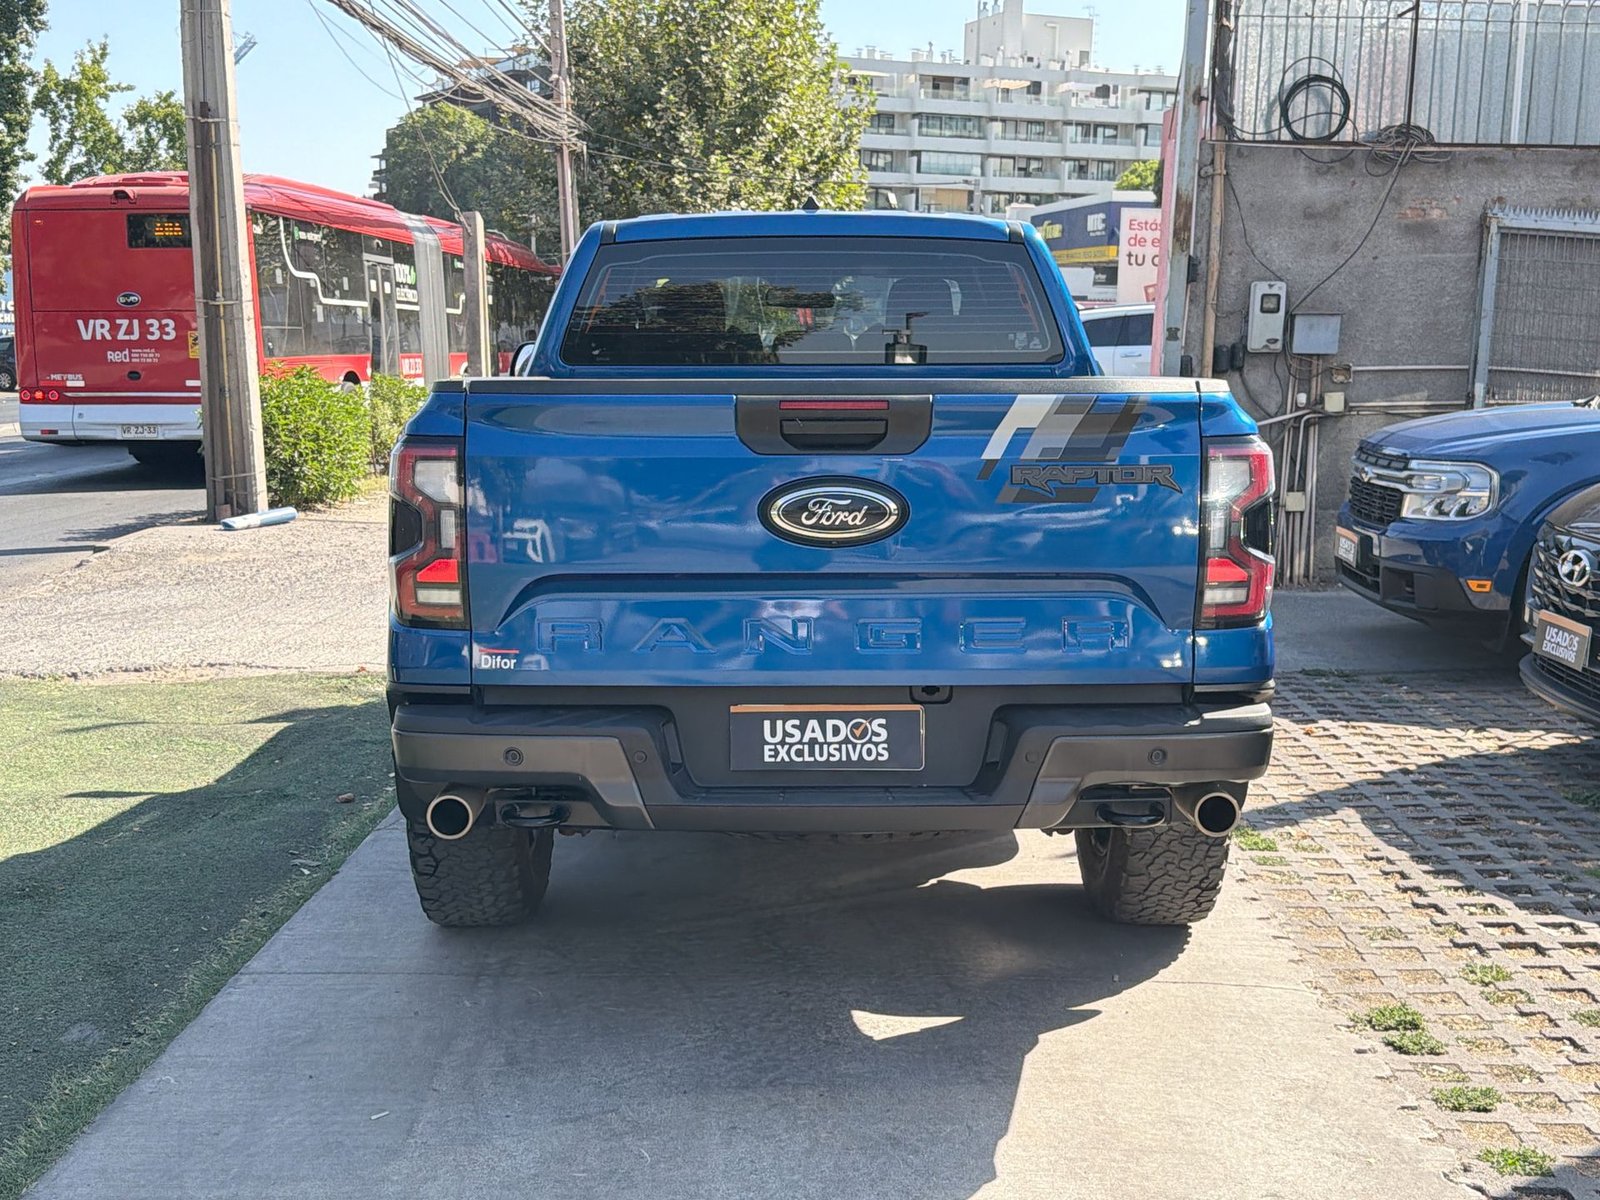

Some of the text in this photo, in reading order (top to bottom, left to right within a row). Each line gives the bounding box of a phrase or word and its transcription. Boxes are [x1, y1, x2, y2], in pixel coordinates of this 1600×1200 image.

[1127, 234, 1147, 247] de
[1126, 251, 1146, 266] tu
[76, 319, 177, 340] VR ZJ 33
[107, 348, 130, 363] Red
[1010, 464, 1184, 496] RAPTOR
[801, 498, 868, 526] Ford
[535, 617, 1129, 654] RANGER
[1545, 625, 1579, 652] USADOS
[481, 655, 517, 669] Difor
[763, 718, 888, 744] USADOS
[763, 743, 889, 762] EXCLUSIVOS
